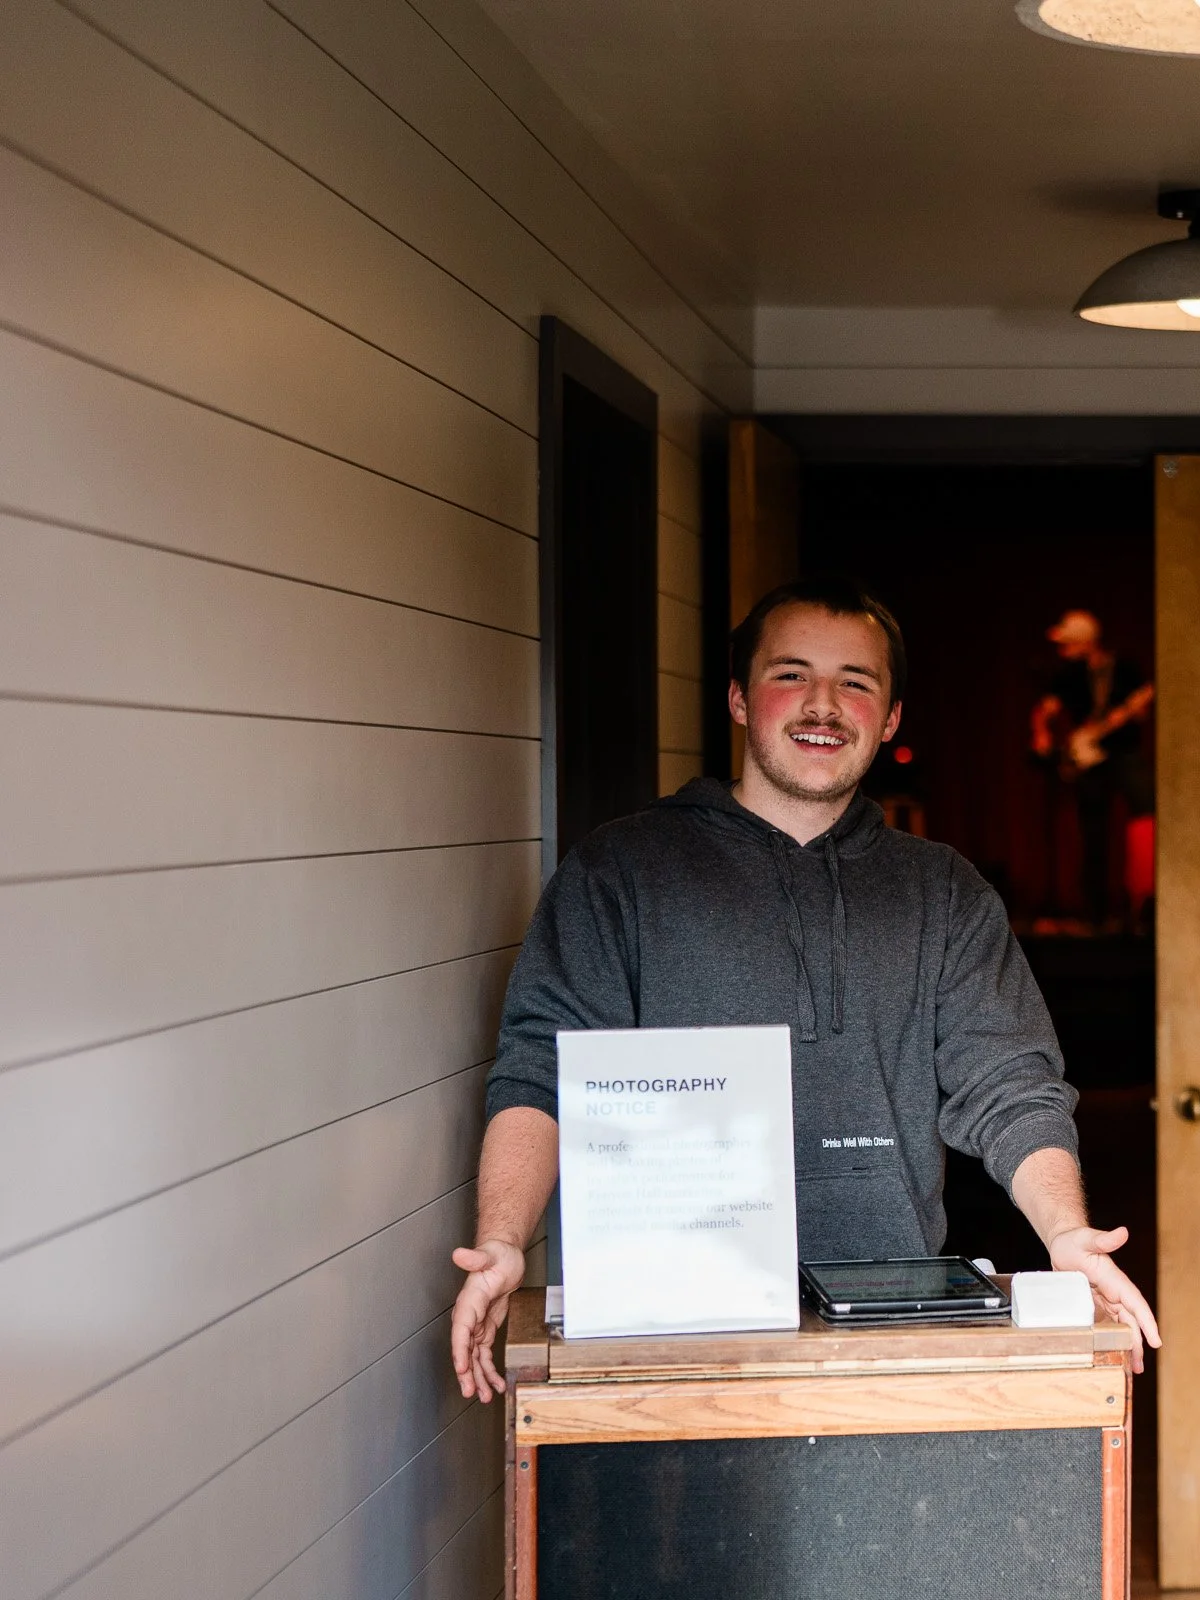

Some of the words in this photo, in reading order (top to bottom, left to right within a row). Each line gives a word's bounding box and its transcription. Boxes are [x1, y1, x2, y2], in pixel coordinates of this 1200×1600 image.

[586, 1077, 728, 1094] PHOTOGRAPHY
[586, 1101, 657, 1116] NOTICE
[587, 1141, 596, 1153] A
[822, 1138, 842, 1148] Drinks
[843, 1137, 857, 1148] Well
[857, 1136, 873, 1147] With
[873, 1136, 895, 1147] Others
[729, 1199, 774, 1213] website
[689, 1216, 744, 1231] channels.
